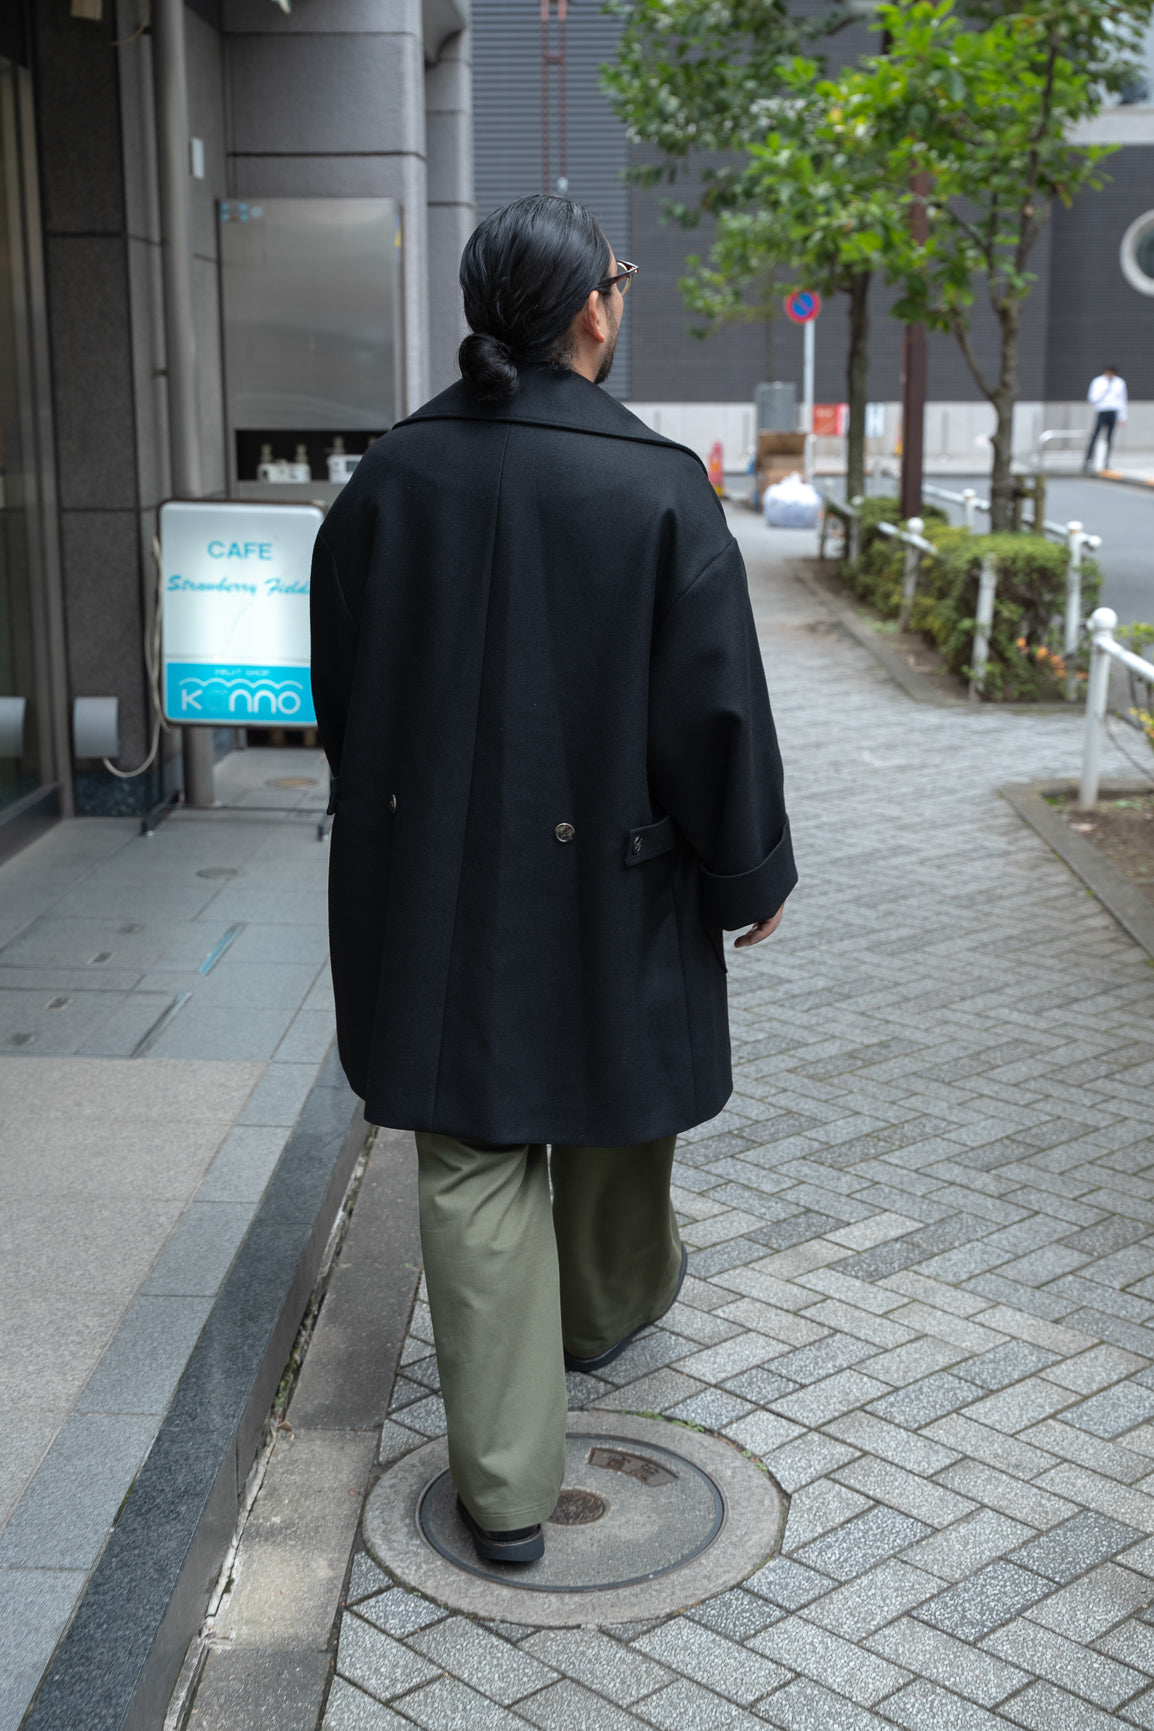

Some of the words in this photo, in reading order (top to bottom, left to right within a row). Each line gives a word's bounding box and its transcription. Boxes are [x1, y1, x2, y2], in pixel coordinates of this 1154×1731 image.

[207, 541, 272, 560] CAFE
[167, 574, 257, 596] Strawberry
[265, 578, 310, 596] Field
